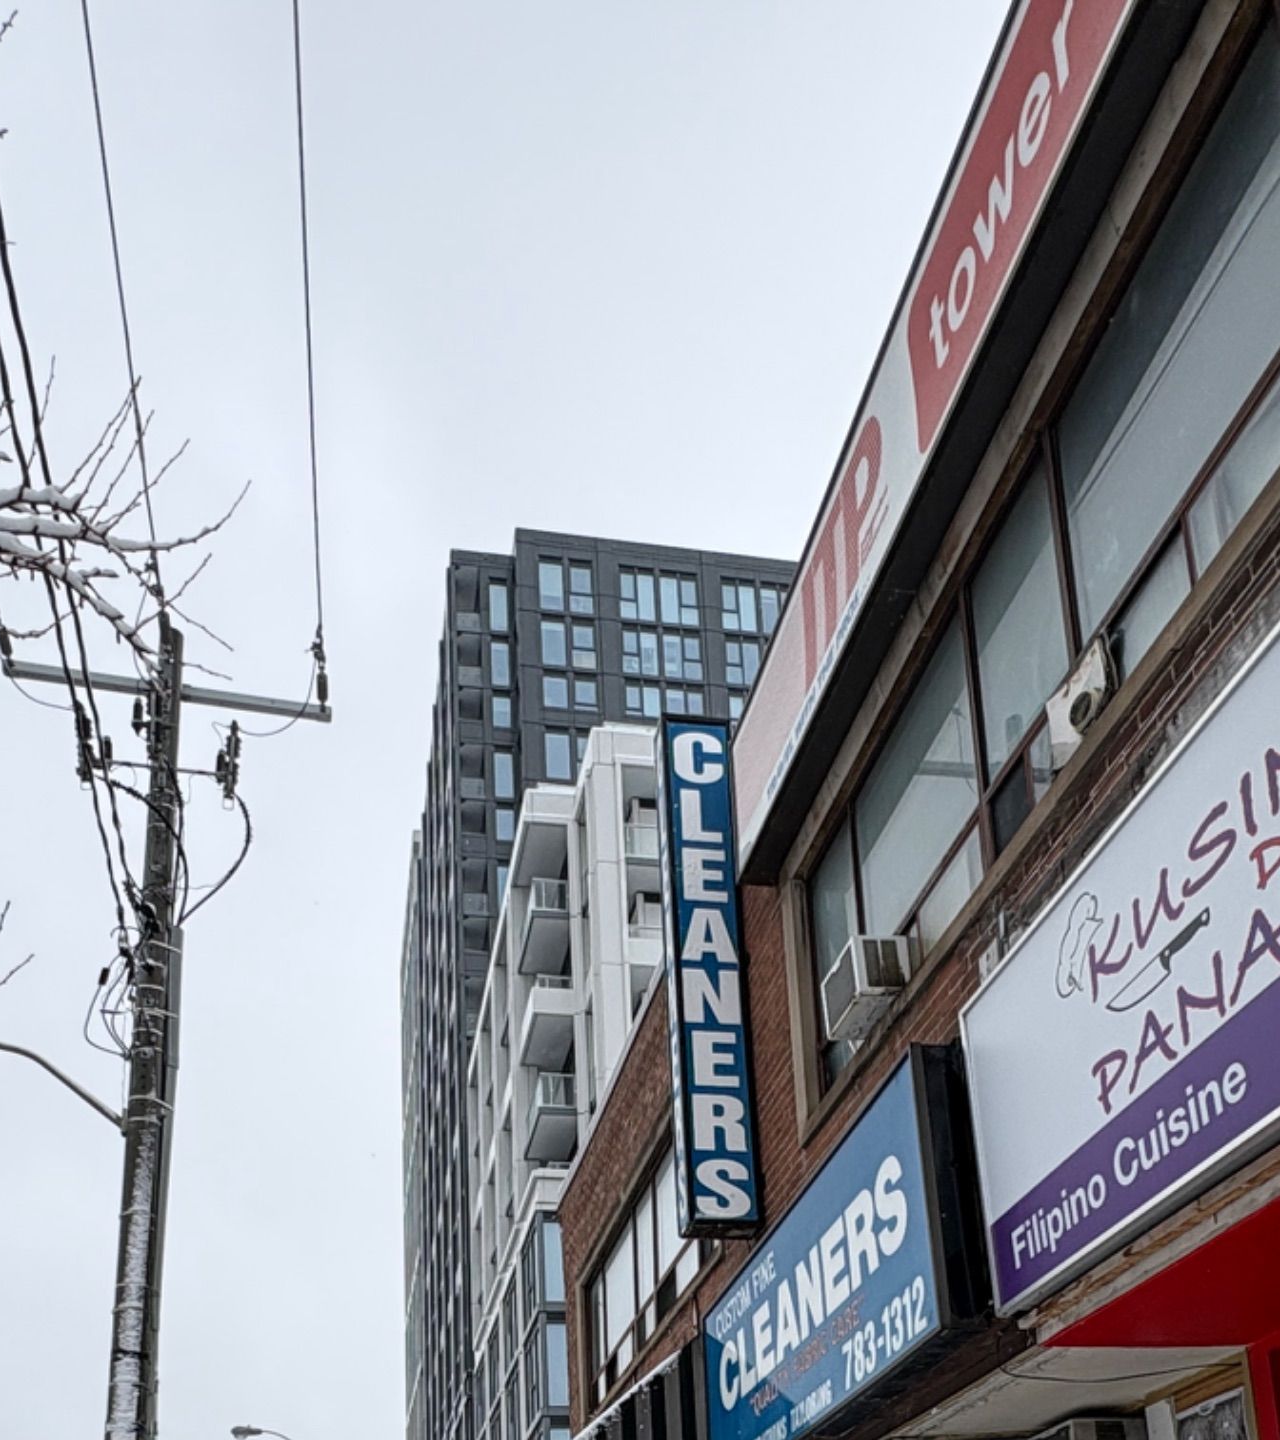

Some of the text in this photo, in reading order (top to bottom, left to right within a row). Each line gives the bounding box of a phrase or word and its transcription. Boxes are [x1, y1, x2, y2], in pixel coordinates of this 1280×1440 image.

[673, 732, 751, 1218] CLEANERS
[1011, 1062, 1247, 1270] Filipino Cuisine
[720, 1155, 908, 1412] CLEANERS
[841, 1275, 928, 1391] 783-1312
